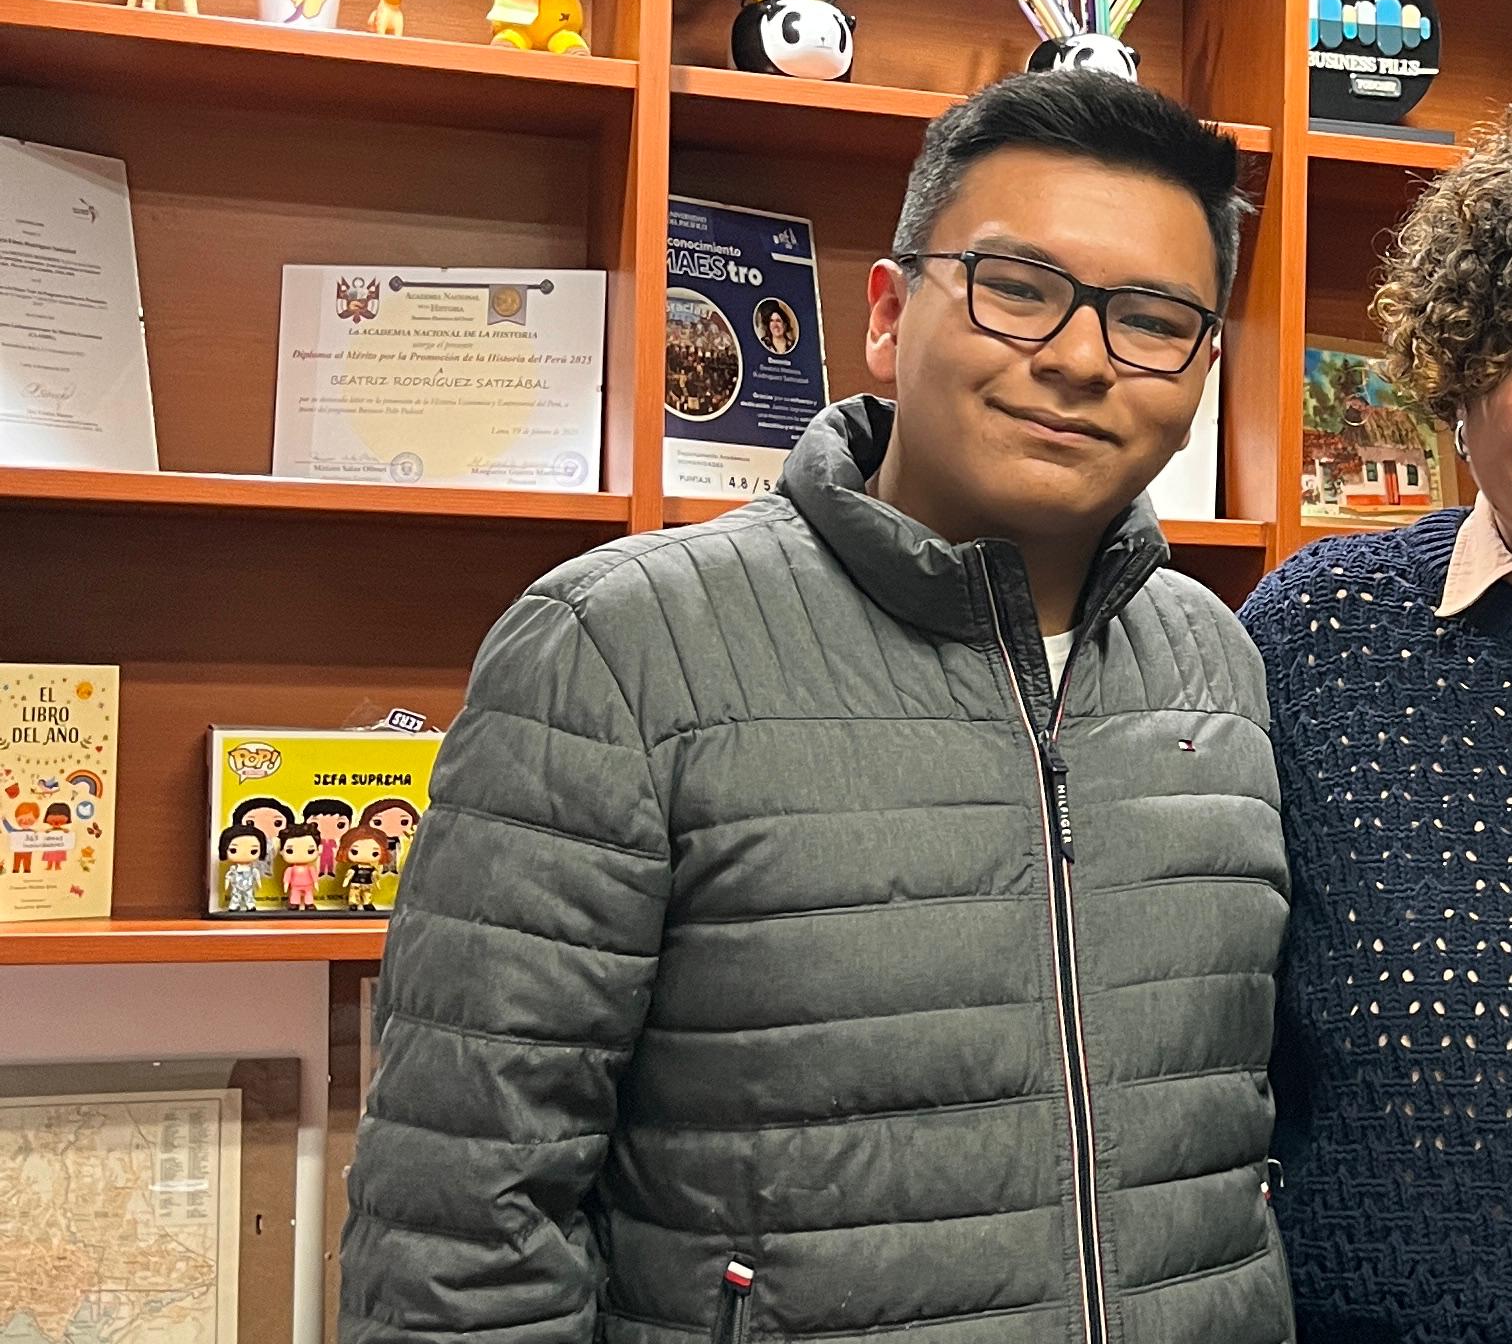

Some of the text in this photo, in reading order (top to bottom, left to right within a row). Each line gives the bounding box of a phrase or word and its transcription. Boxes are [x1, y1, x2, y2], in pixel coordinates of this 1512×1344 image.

[667, 237, 741, 257] conocimiento
[330, 369, 550, 390] BEATRIZ RODRÍGUEZ SATIZÁBAL
[763, 479, 771, 492] 5
[40, 686, 56, 703] EL
[22, 706, 69, 726] LIBRO
[12, 727, 41, 743] DEL
[228, 747, 282, 771] POP!
[313, 773, 412, 786] JEFA SUPREMA
[1056, 784, 1072, 844] HILFIGER
